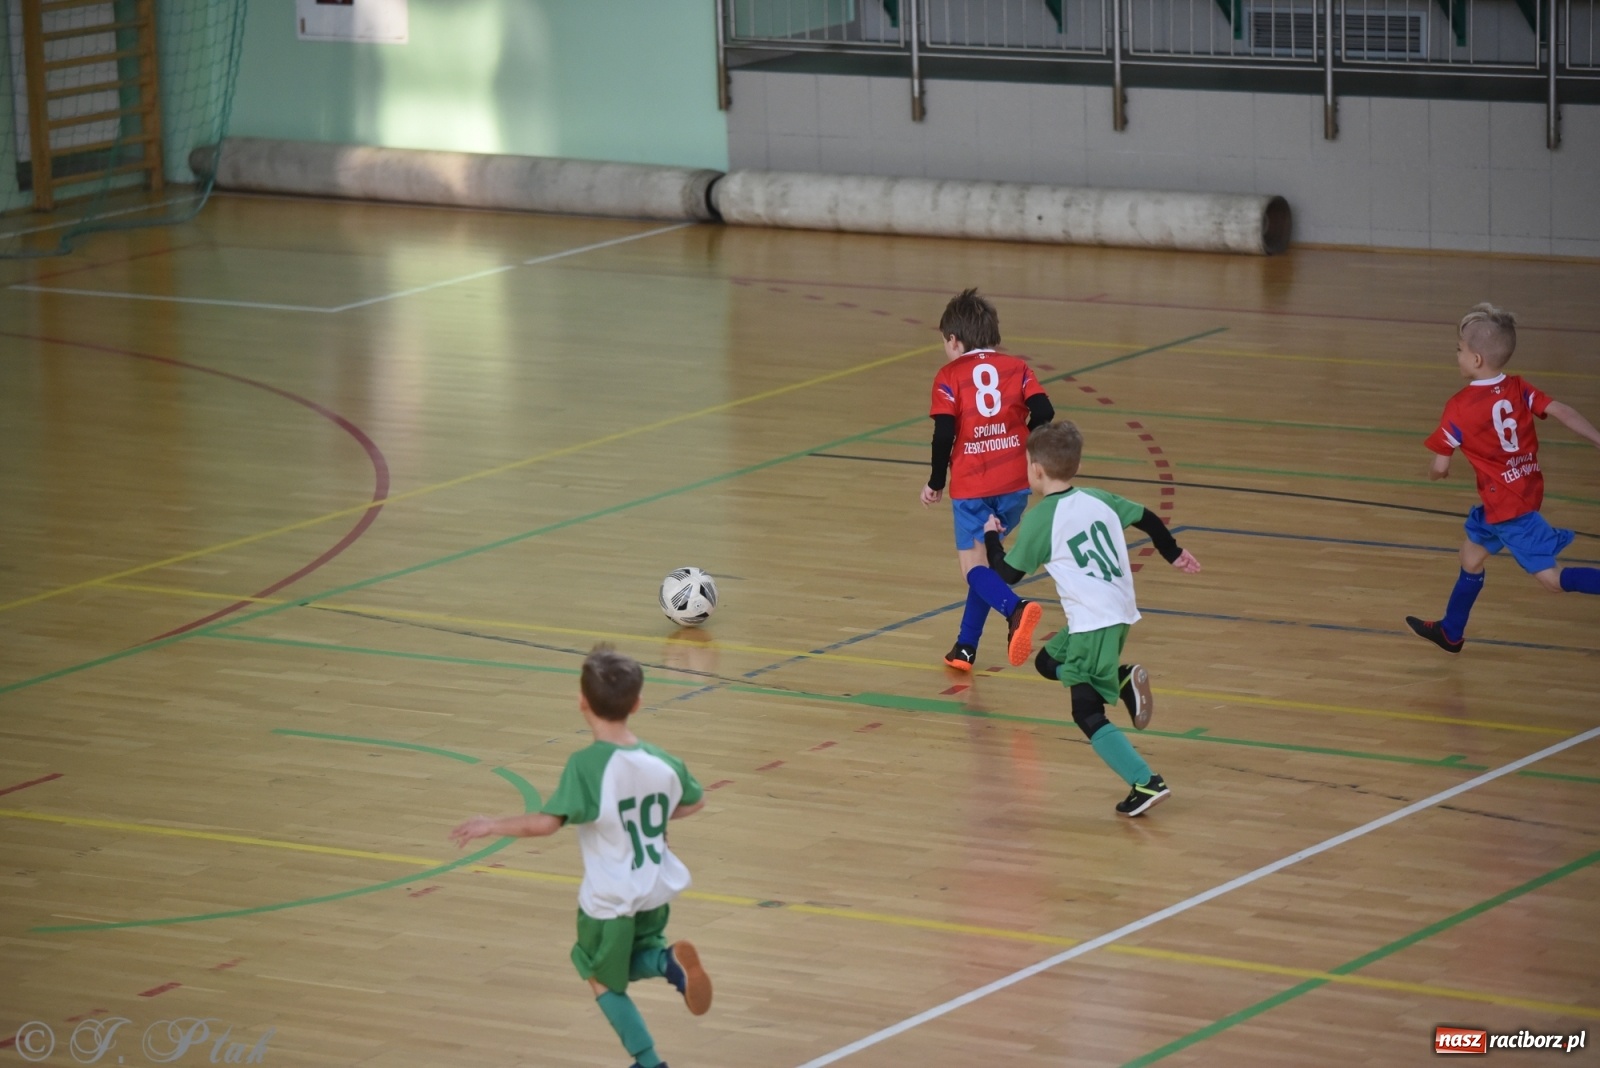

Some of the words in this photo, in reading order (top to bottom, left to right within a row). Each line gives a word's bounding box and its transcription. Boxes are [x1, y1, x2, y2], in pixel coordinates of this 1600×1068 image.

[972, 363, 1002, 418] 8
[963, 434, 1021, 455] ZEBRZYDOWICE
[973, 422, 1007, 439] SPÓJNIA
[1492, 399, 1520, 453] 6
[1066, 520, 1124, 583] 50
[618, 792, 669, 871] 59
